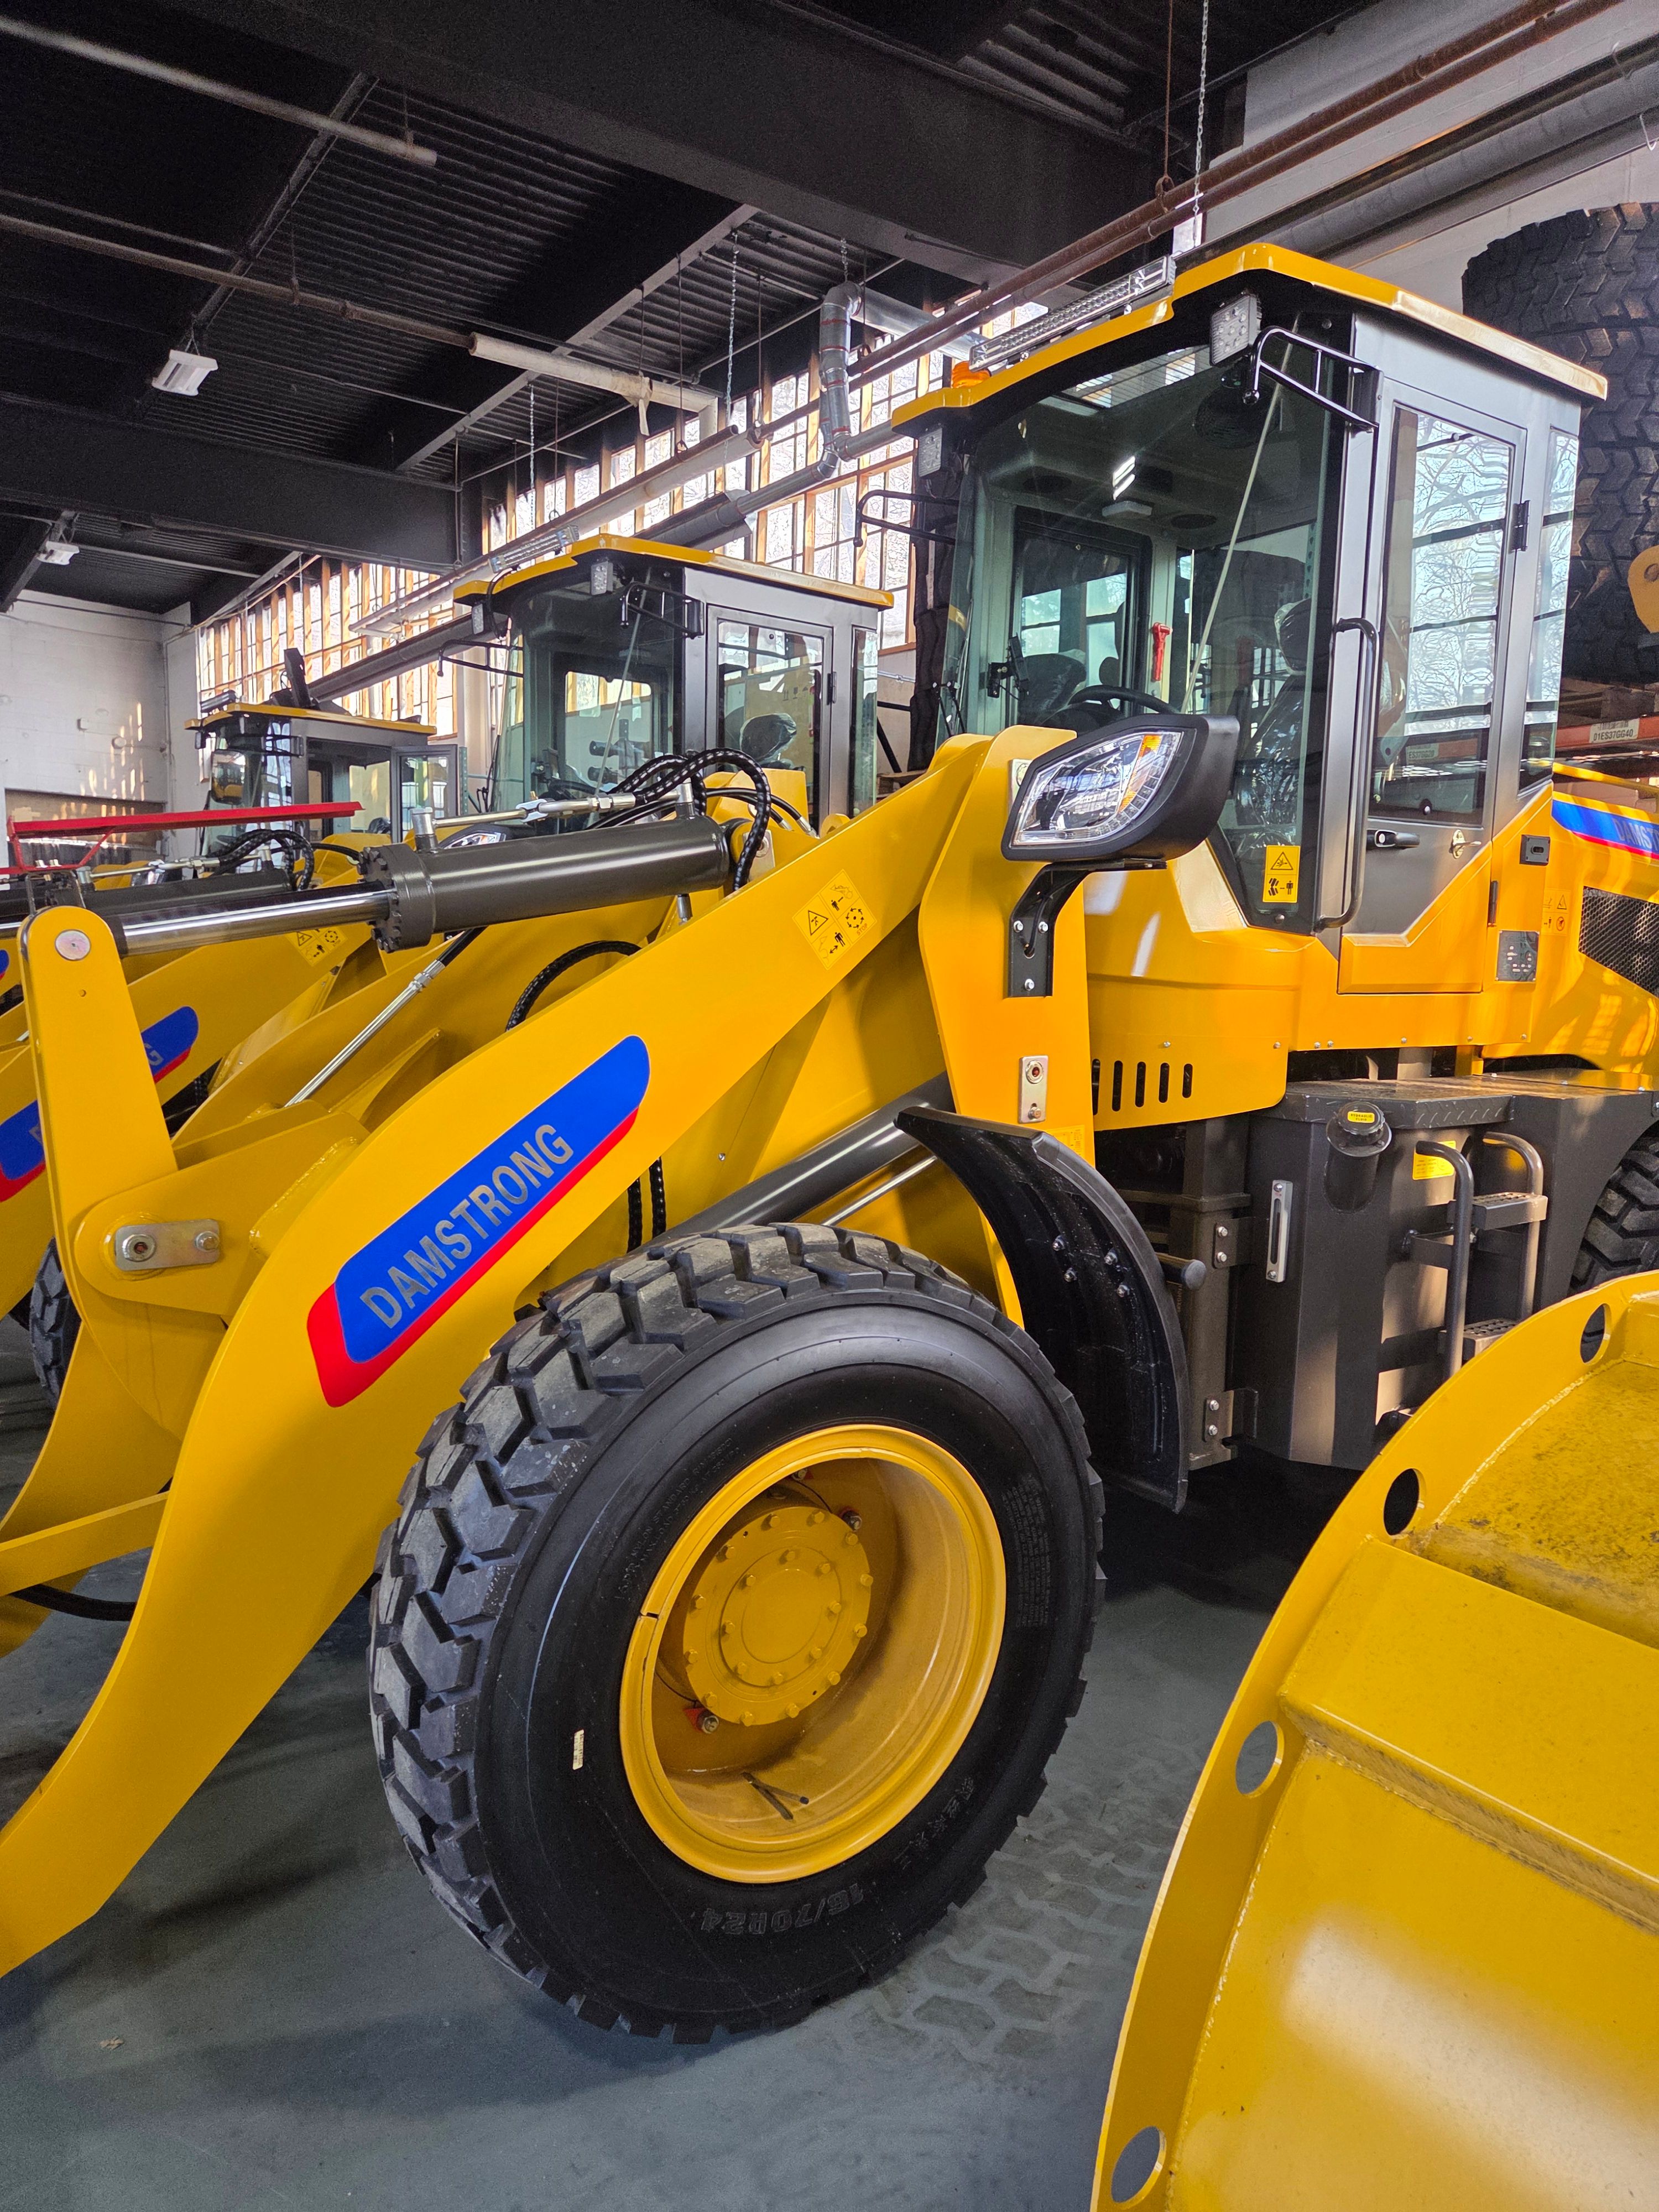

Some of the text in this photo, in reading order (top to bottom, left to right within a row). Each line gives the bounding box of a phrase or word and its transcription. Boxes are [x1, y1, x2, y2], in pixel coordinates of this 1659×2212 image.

[1593, 729, 1634, 742] 01ES37GG40
[857, 923, 868, 936] STOP
[359, 1124, 574, 1329] DAMSTRONG
[630, 1526, 653, 1558] NYLON
[653, 1478, 690, 1525] STANDARD
